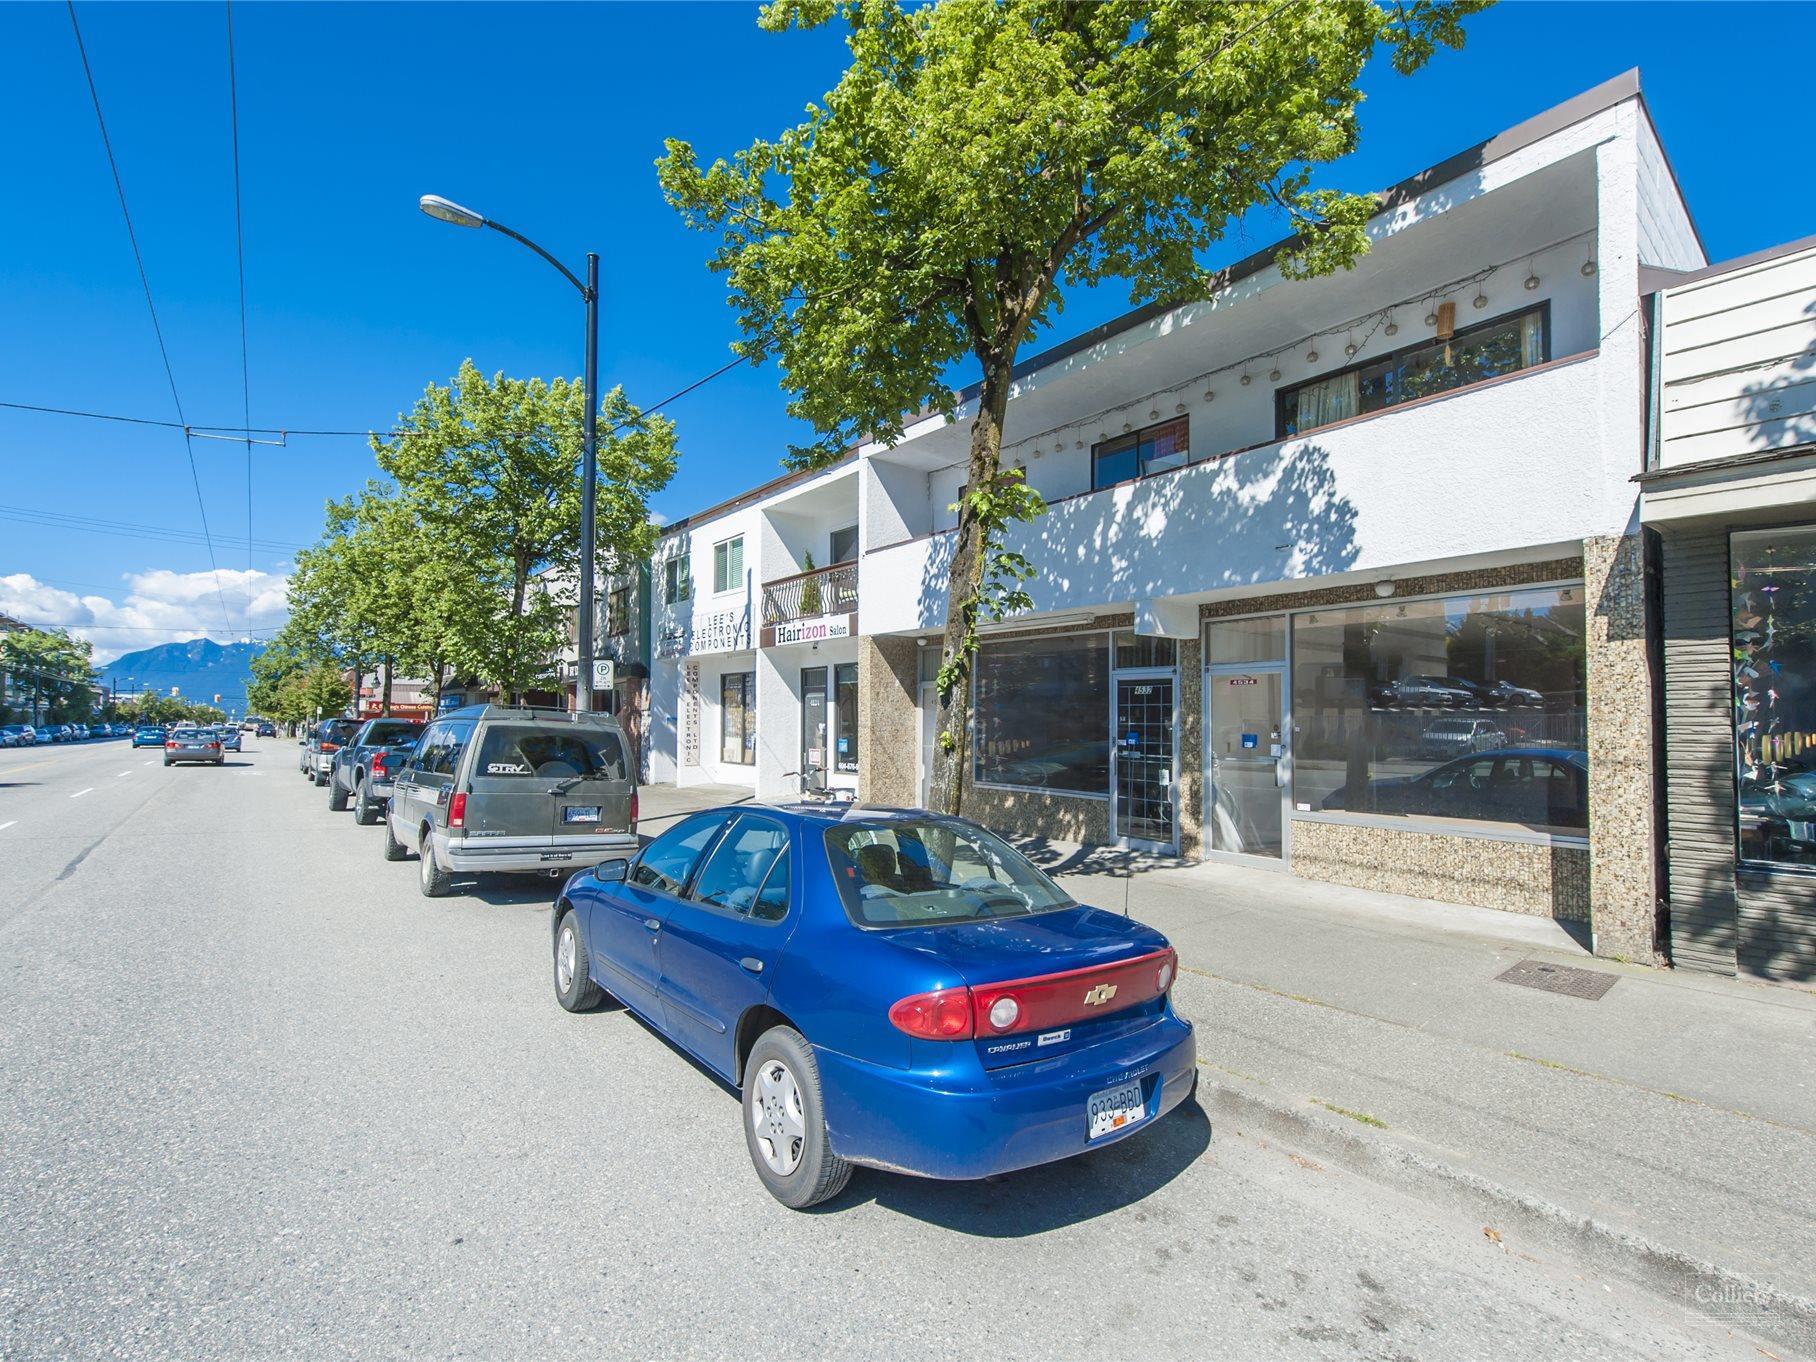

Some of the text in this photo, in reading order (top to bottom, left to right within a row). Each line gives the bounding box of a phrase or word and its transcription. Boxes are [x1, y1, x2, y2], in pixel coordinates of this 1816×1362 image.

[708, 612, 734, 626] LEE'S
[691, 621, 751, 640] ELECTRONIC
[778, 623, 847, 643] Hairizon Salon
[689, 633, 751, 652] COMPONENTS
[1106, 1064, 1149, 1084] CHEVROLET
[1091, 1097, 1115, 1125] 933
